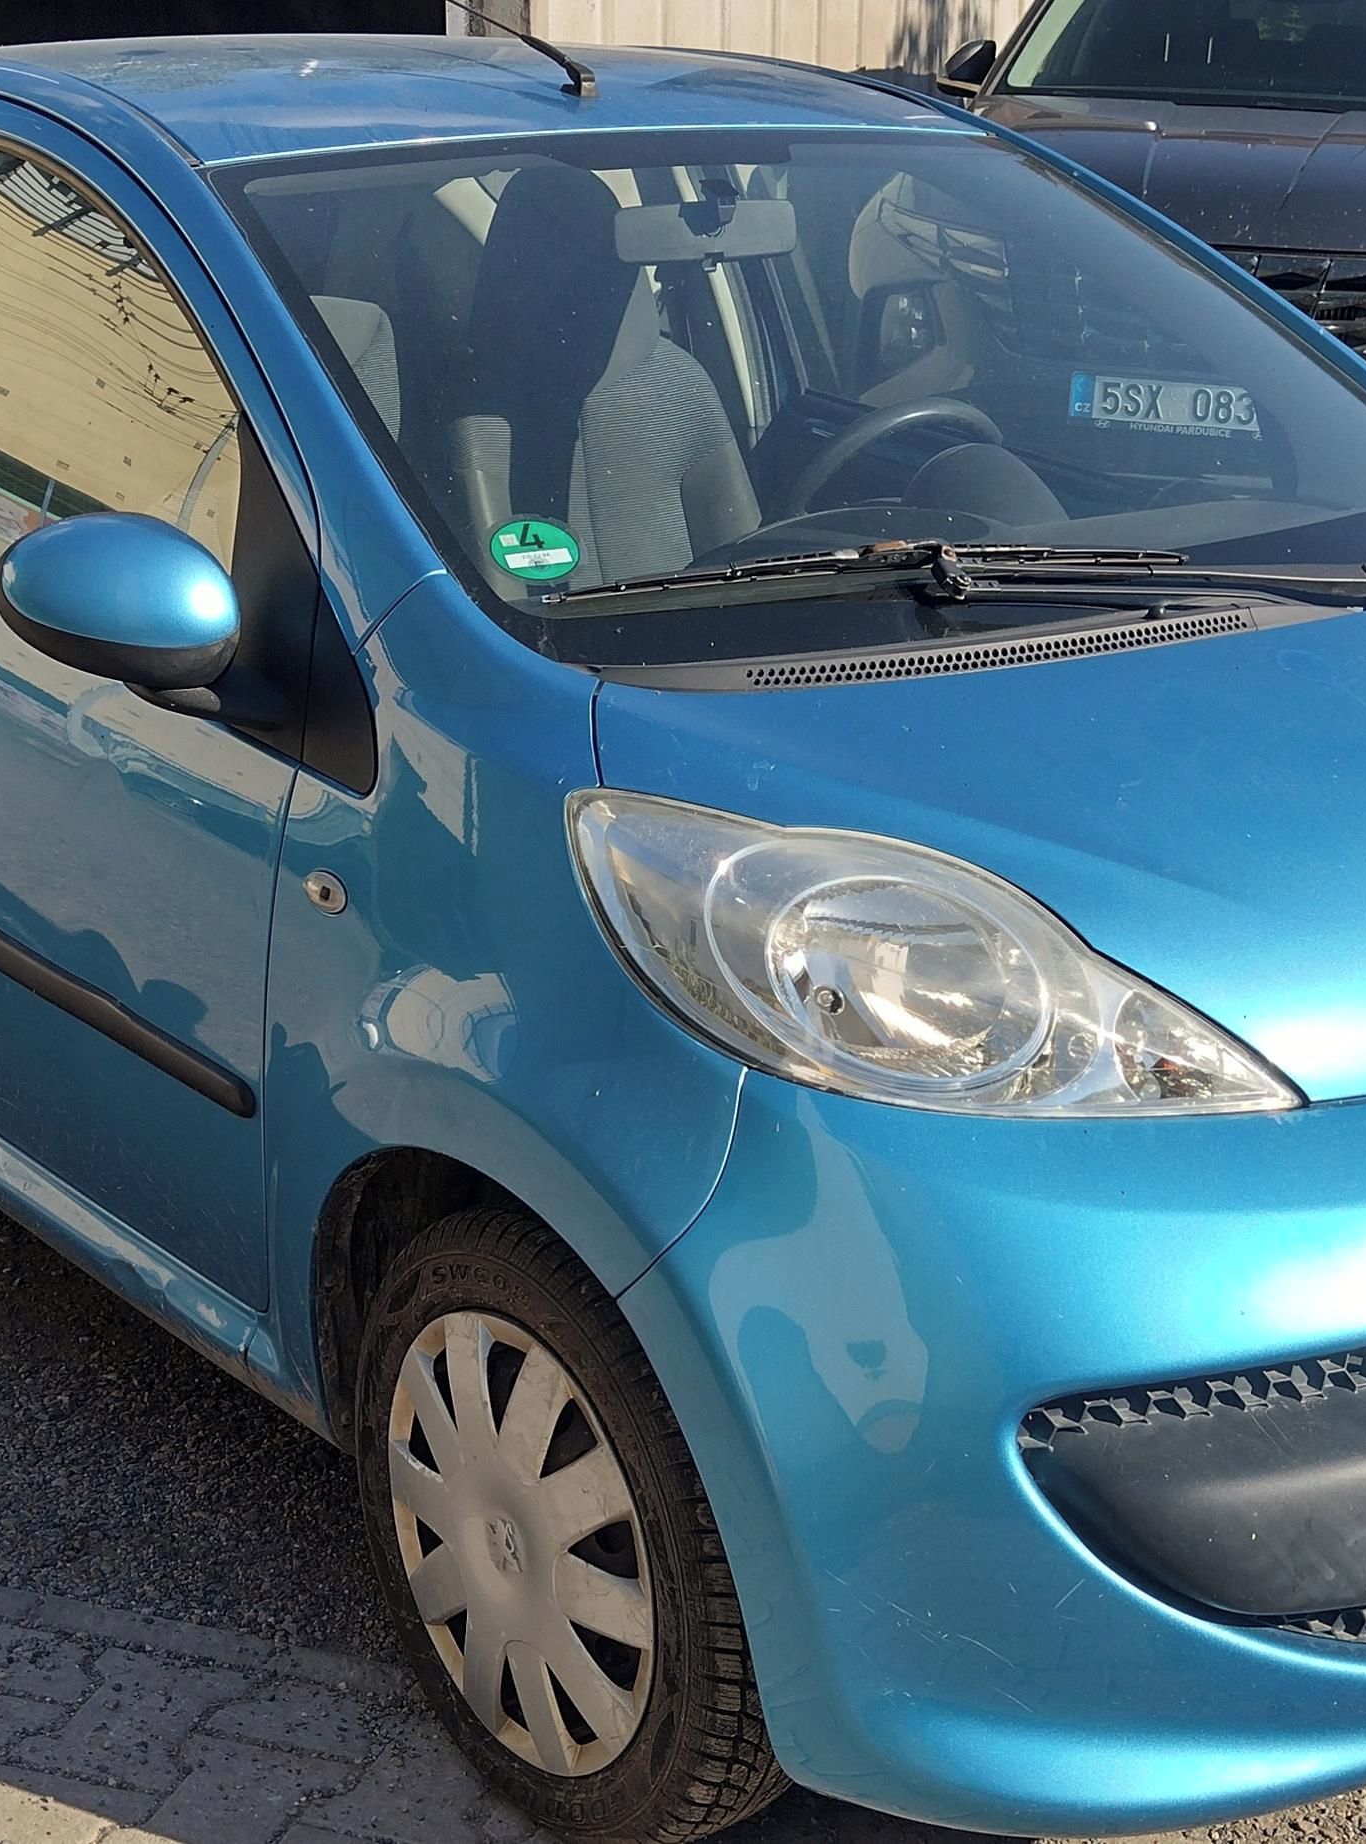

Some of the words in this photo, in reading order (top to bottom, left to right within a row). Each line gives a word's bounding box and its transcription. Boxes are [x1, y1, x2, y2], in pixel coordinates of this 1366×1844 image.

[1074, 402, 1091, 413] CZ
[1101, 381, 1163, 420] 5SX
[1130, 422, 1173, 434] HYUNDAI
[1176, 426, 1232, 438] PARDUBICE
[520, 523, 545, 549] 4
